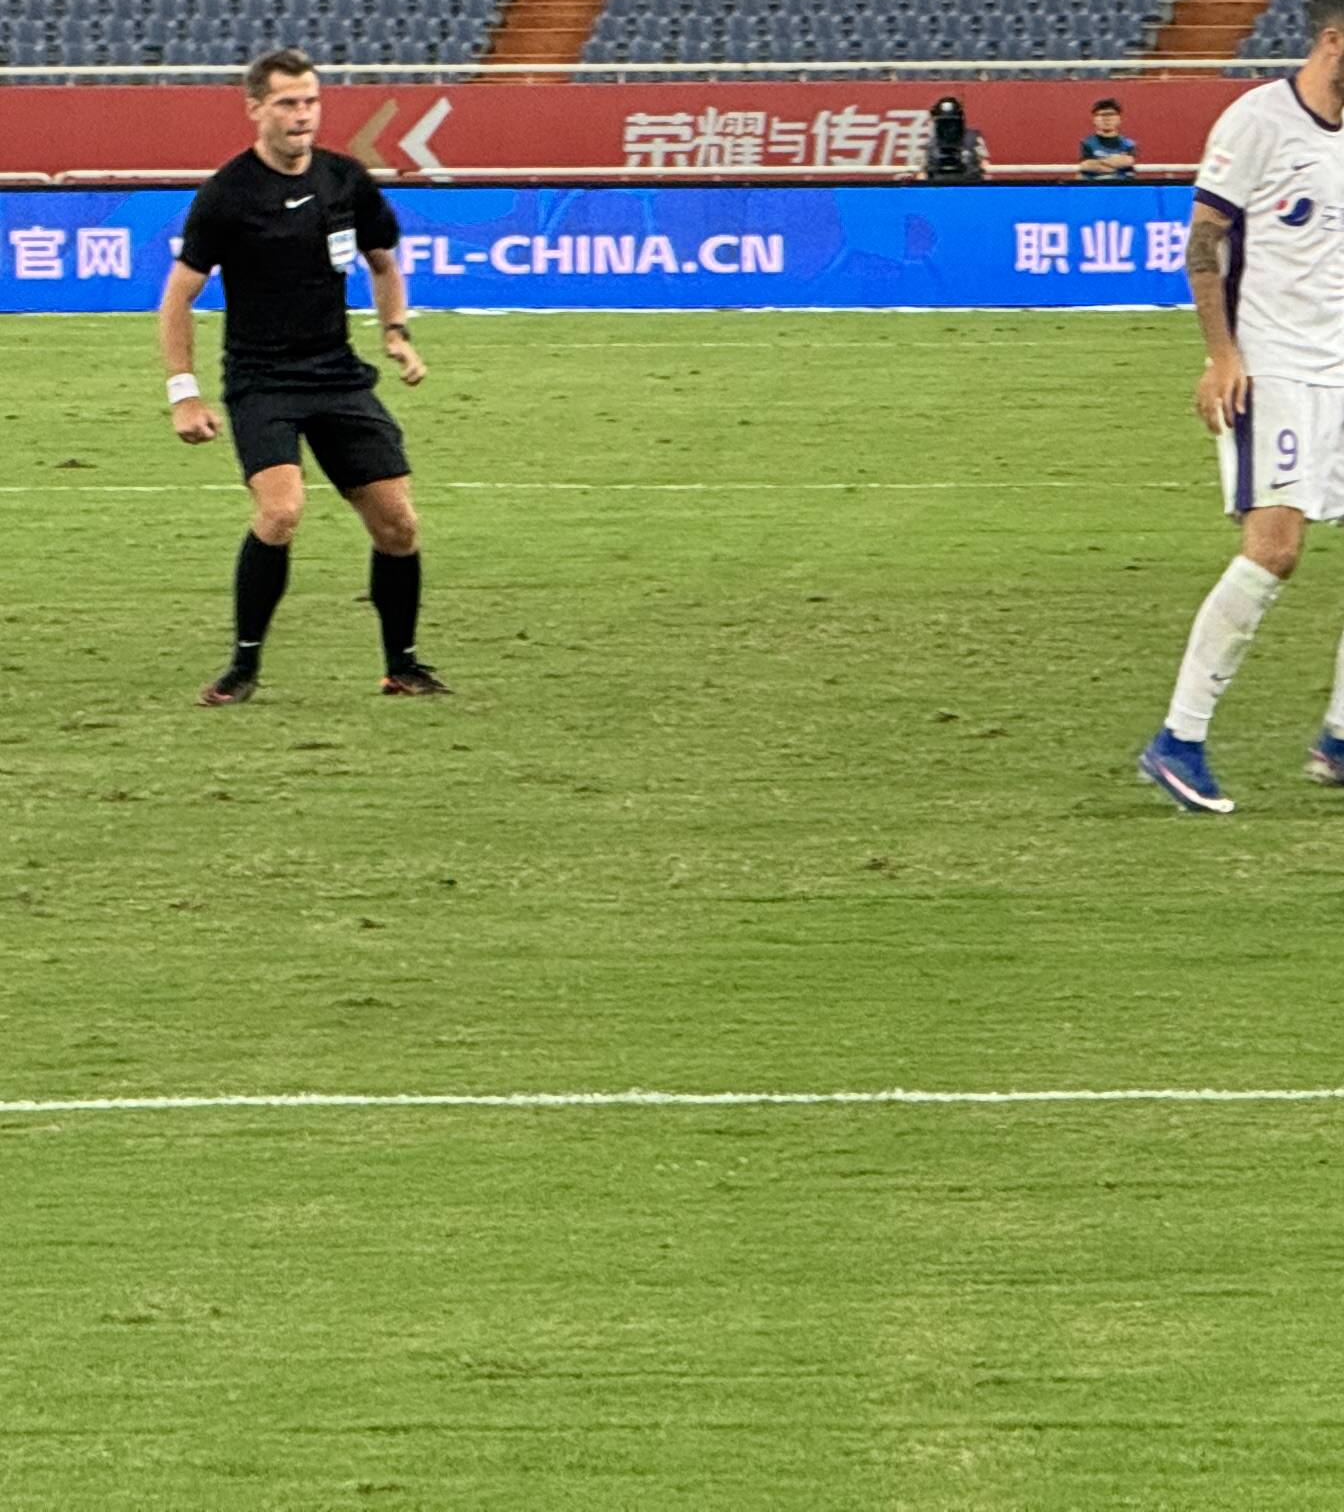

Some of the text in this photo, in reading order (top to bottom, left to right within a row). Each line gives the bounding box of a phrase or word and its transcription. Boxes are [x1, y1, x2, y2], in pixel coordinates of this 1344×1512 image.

[622, 105, 932, 168] 荣耀与传承
[10, 227, 131, 280] 官网
[1276, 429, 1299, 471] 9
